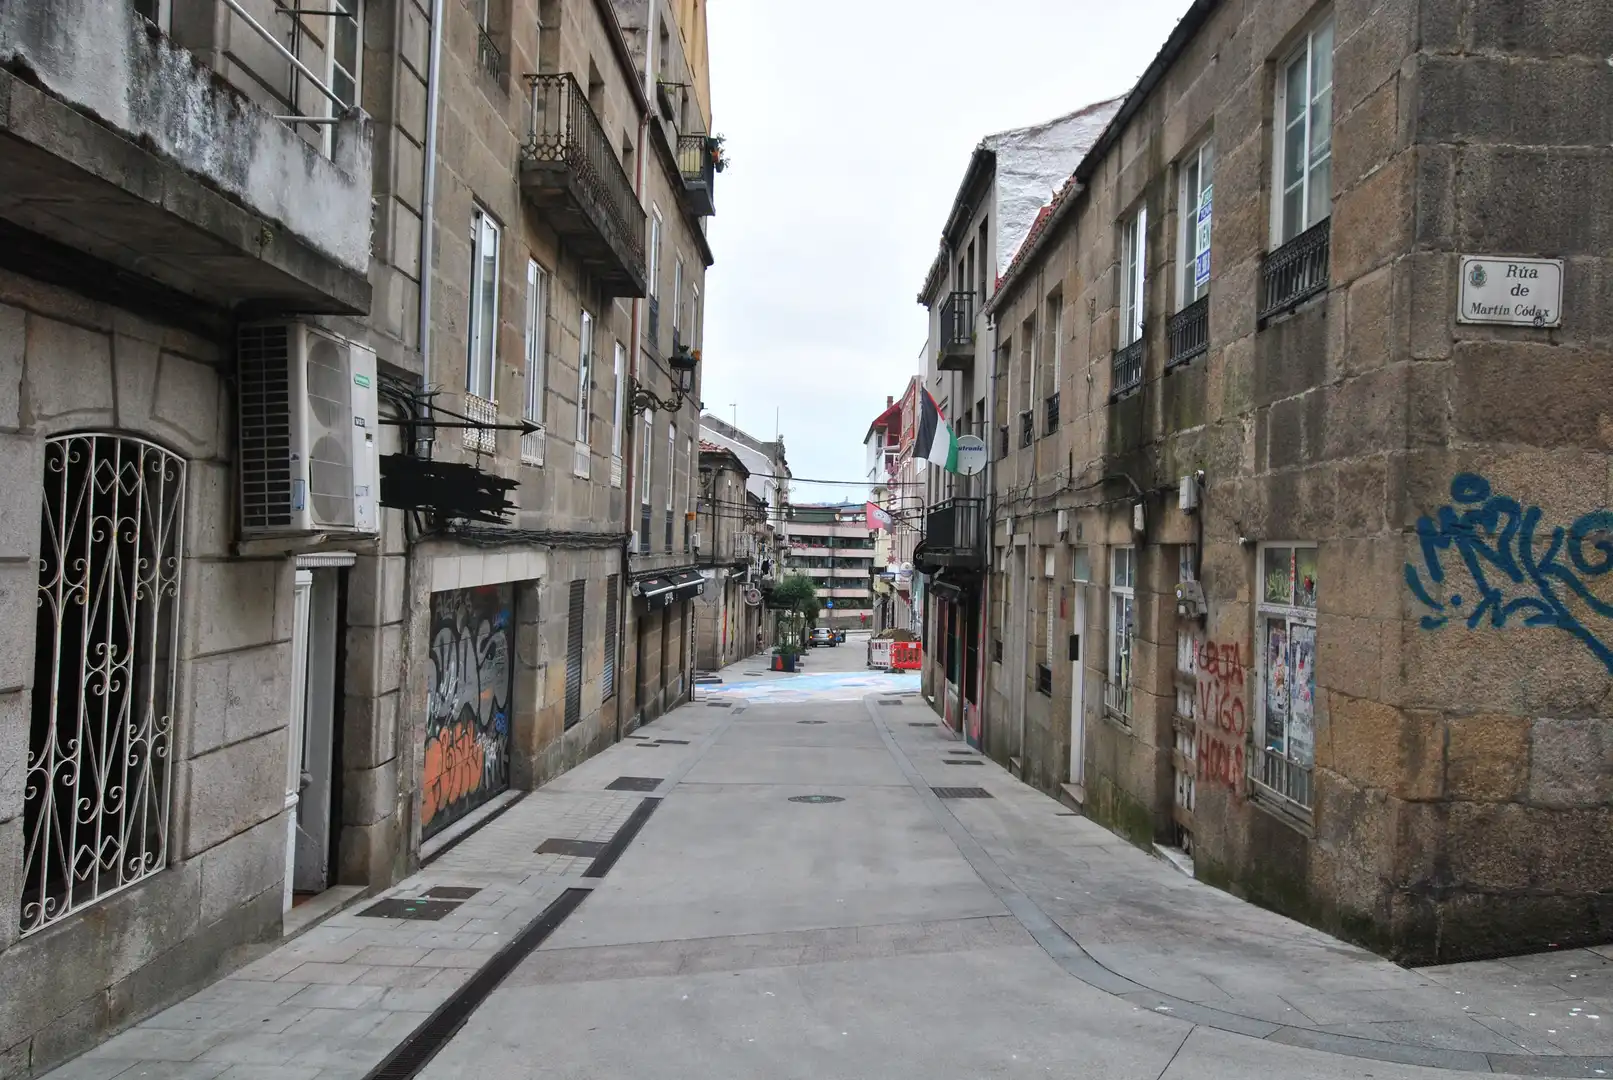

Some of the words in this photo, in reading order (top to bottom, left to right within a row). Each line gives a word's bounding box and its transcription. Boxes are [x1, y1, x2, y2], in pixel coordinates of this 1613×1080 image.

[1506, 264, 1539, 279] Rúa
[1510, 283, 1530, 297] de
[1470, 302, 1510, 316] Martín
[1514, 303, 1550, 317] Códax
